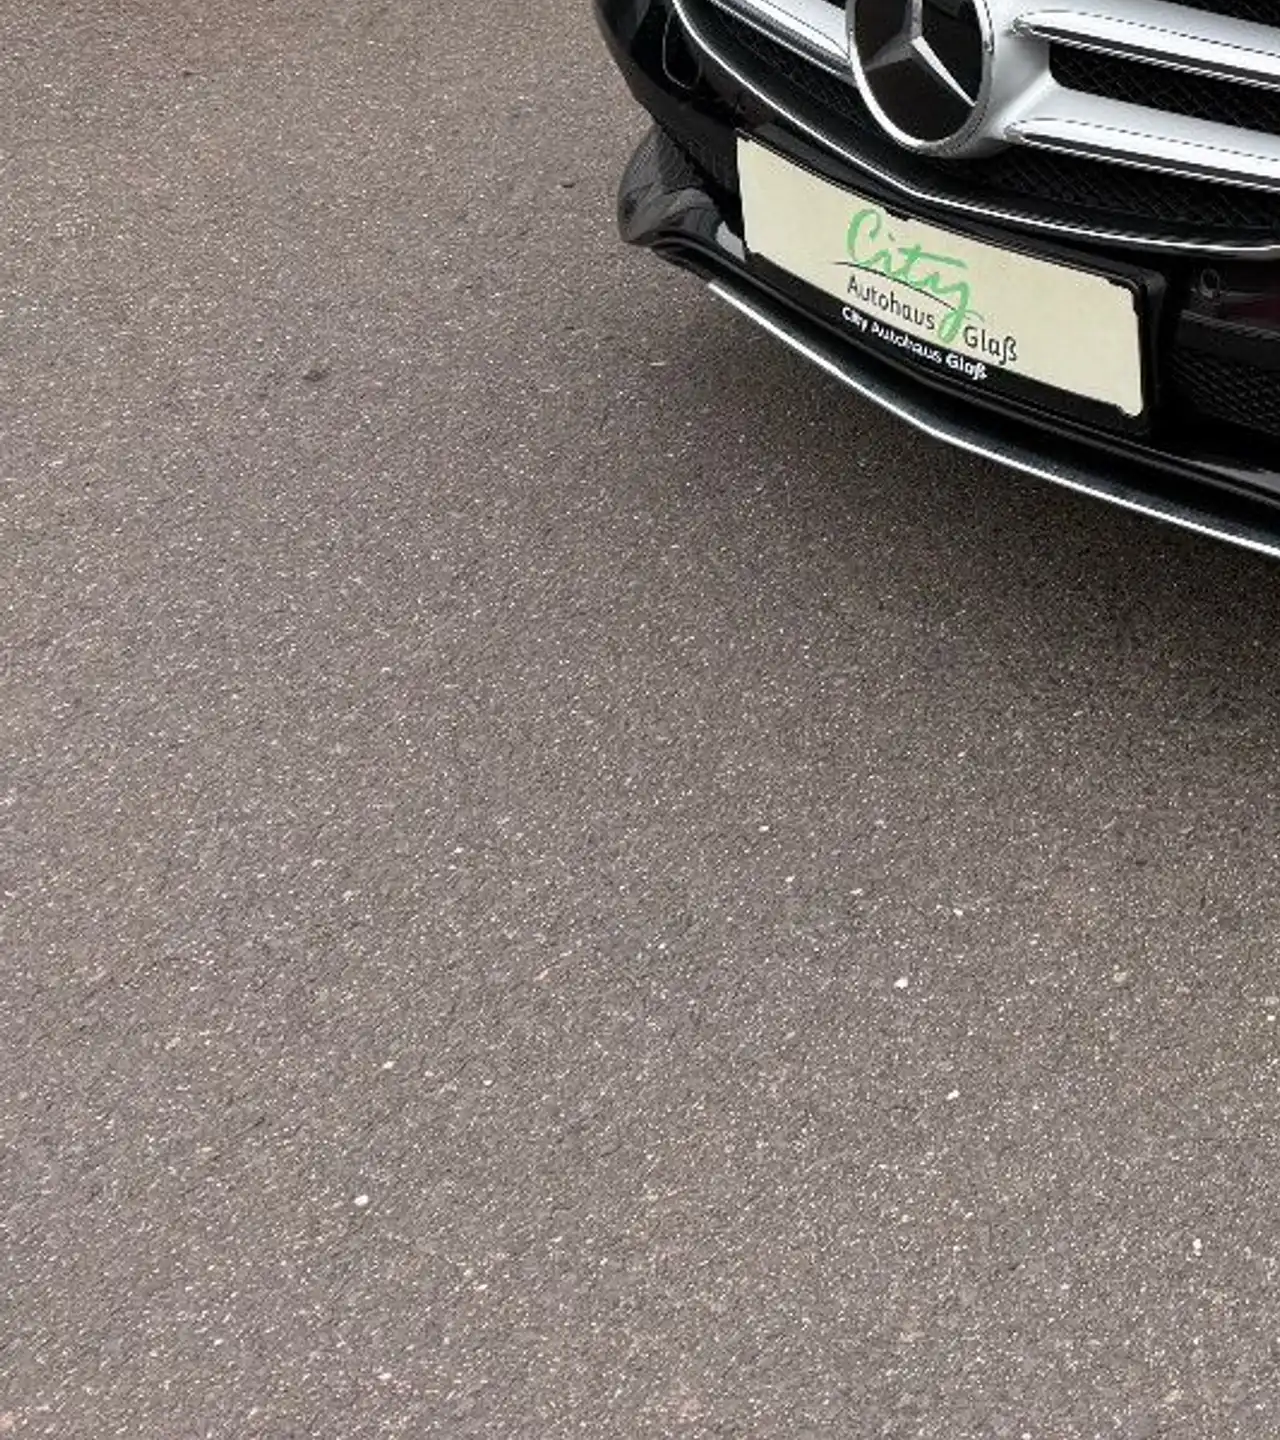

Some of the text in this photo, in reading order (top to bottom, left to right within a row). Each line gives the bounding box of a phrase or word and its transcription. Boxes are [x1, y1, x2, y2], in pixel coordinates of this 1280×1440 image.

[846, 209, 985, 343] City
[847, 275, 1018, 365] Autohaus Glaß
[842, 307, 868, 331] City
[871, 325, 942, 364] Autohaus
